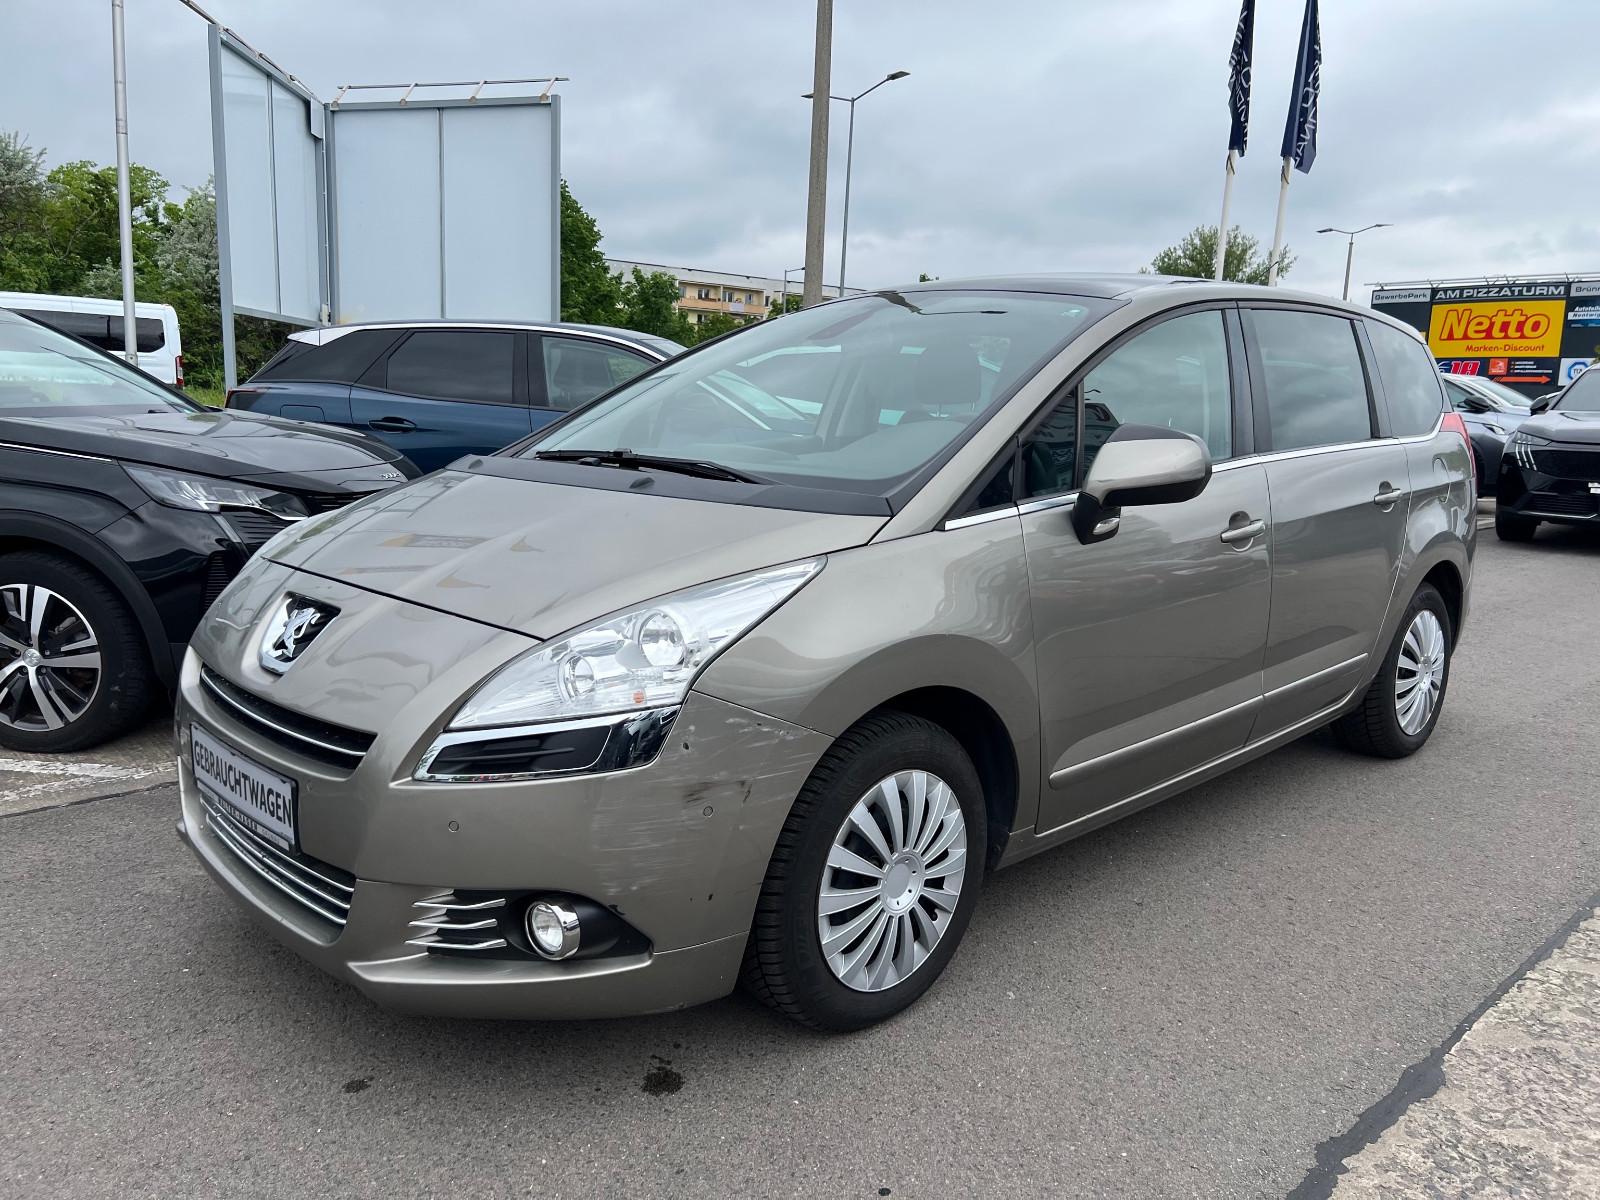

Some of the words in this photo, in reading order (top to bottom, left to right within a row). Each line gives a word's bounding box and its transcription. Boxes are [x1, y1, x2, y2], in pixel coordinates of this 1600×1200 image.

[1375, 292, 1427, 301] GewerbePark
[1434, 289, 1460, 300] AM
[1463, 285, 1565, 299] PIZZATURM
[1439, 308, 1551, 341] Netto
[1465, 343, 1545, 353] Marken-Discount
[194, 740, 292, 828] GEBRAUCHTWAGEN
